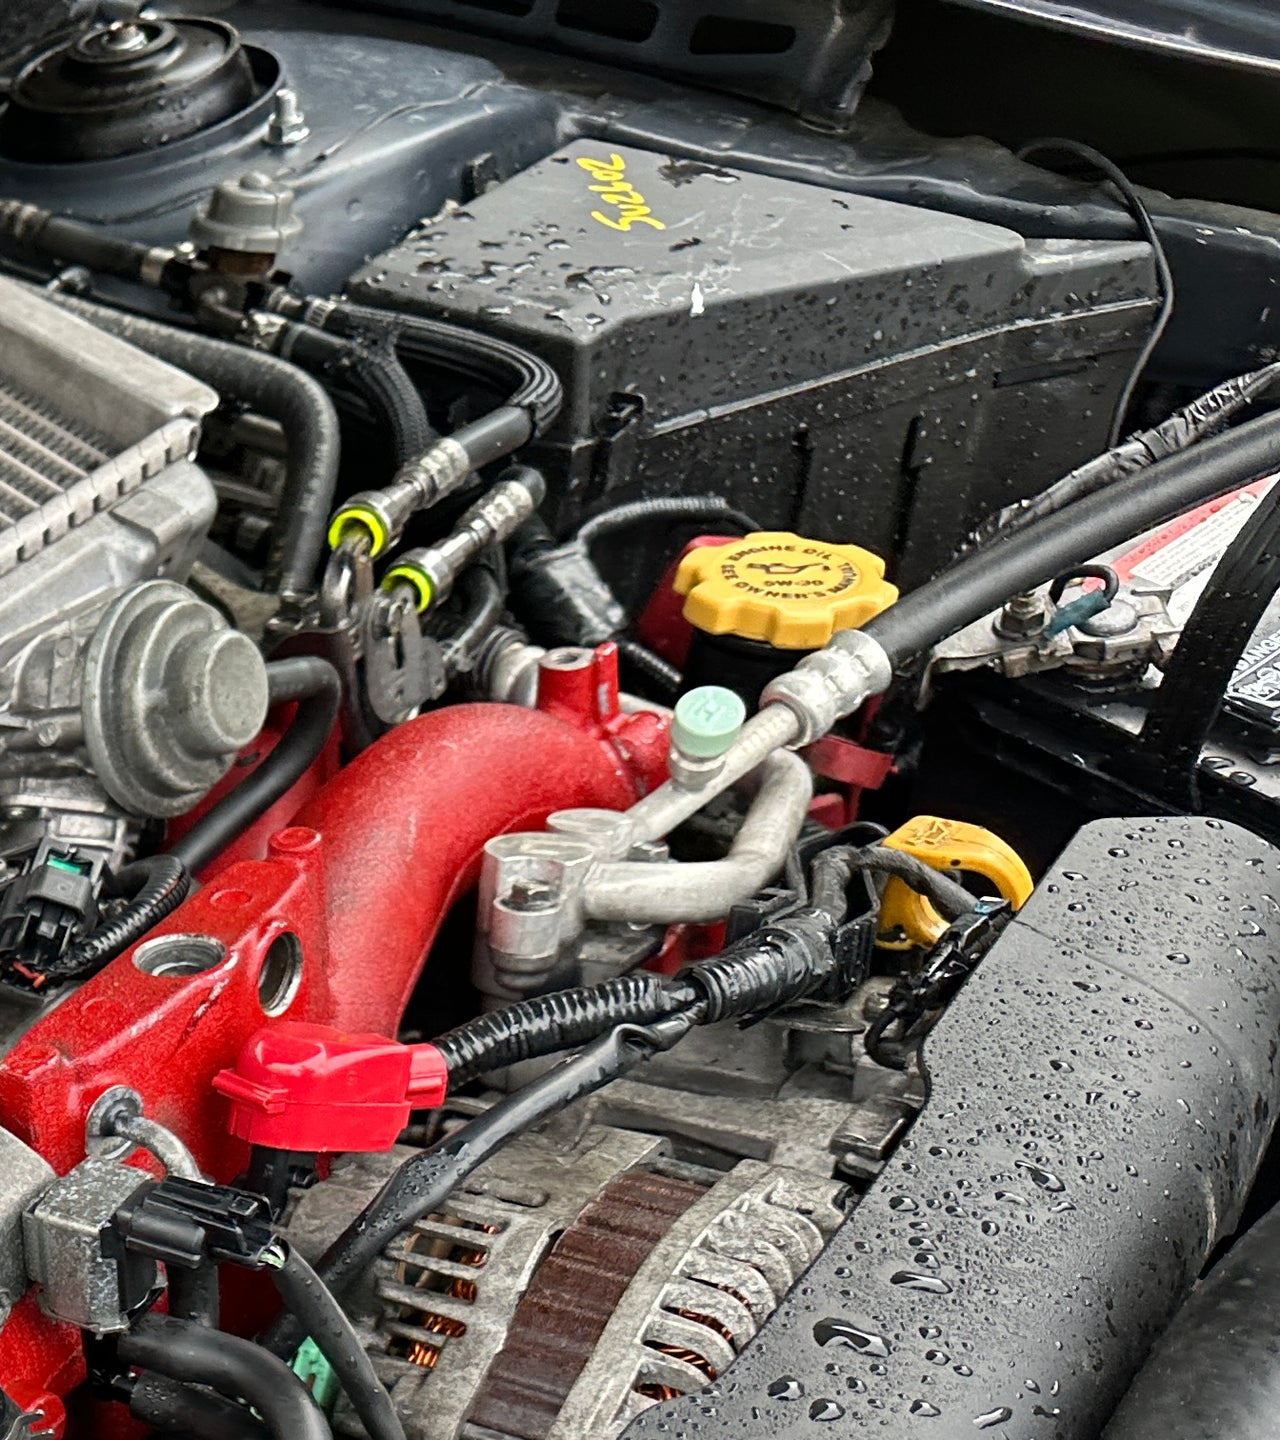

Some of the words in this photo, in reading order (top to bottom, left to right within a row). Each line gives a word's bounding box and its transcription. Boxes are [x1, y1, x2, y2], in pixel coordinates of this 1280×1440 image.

[727, 545, 796, 562] ENGINE
[802, 548, 833, 561] OIL
[721, 564, 739, 581] SEE
[734, 581, 828, 599] OWNER'S
